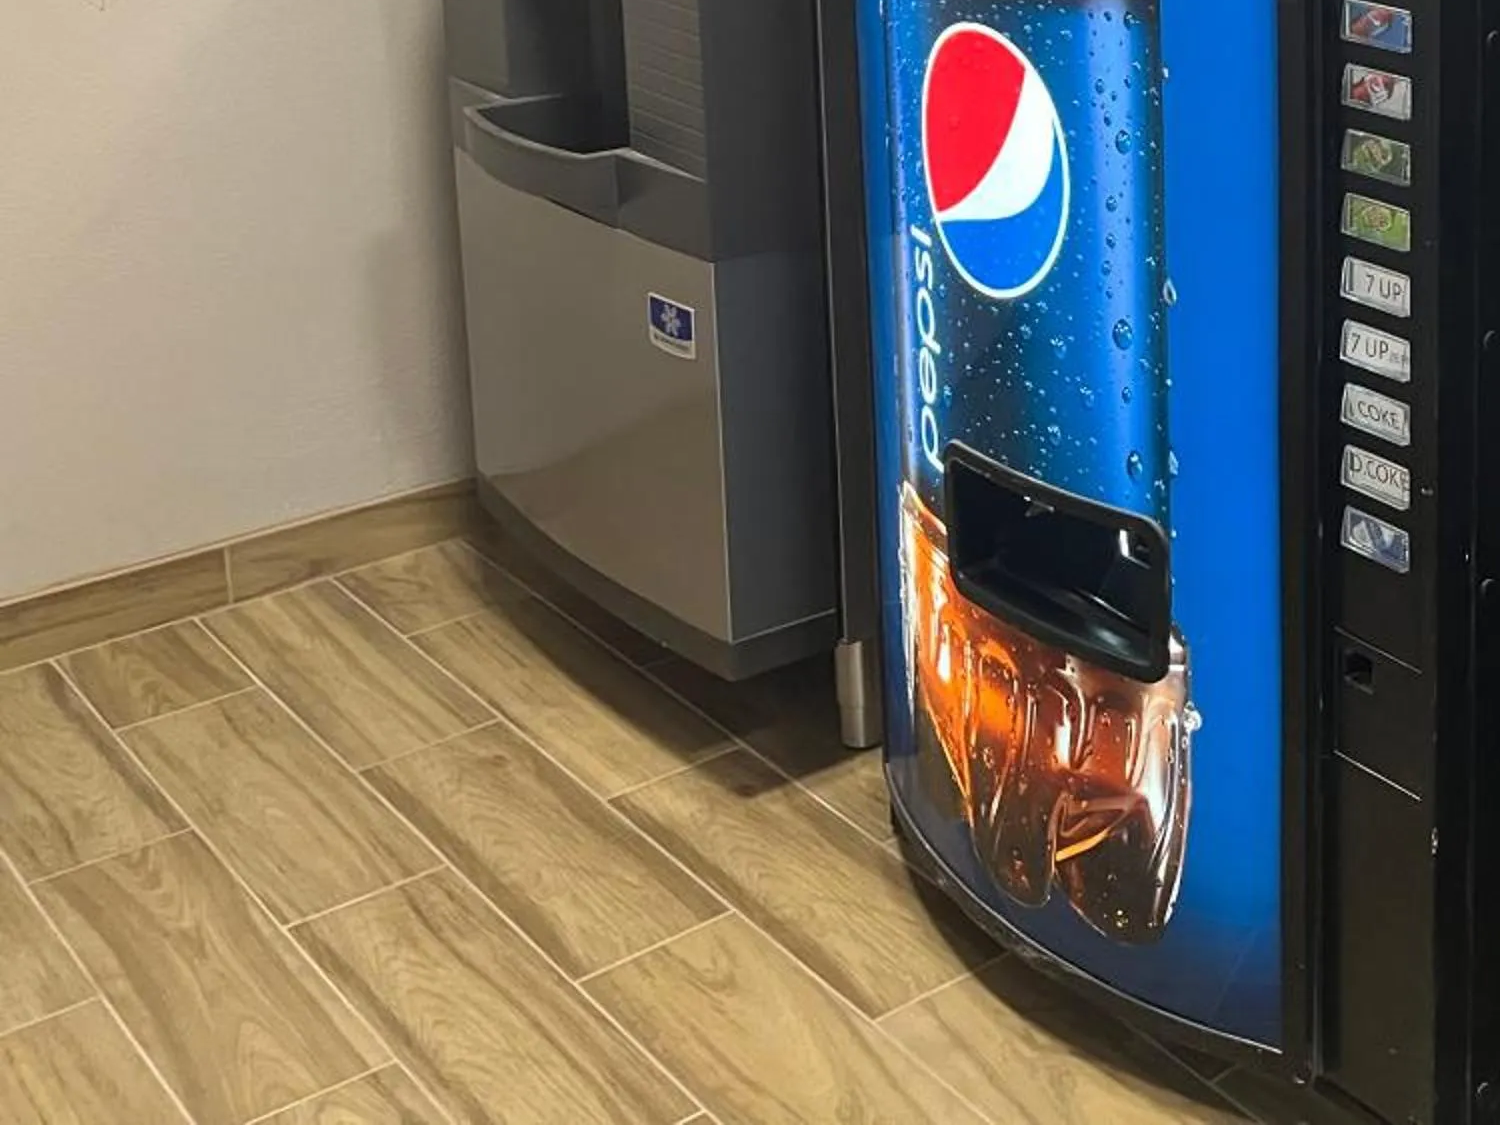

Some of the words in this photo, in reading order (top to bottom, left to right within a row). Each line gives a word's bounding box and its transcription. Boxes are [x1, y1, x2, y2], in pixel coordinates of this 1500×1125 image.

[1366, 274, 1375, 293] 7
[1380, 278, 1402, 300] UP
[910, 223, 945, 473] pepsi
[1351, 332, 1361, 353] 7
[1366, 339, 1388, 359] UP
[1358, 401, 1399, 430] COKE
